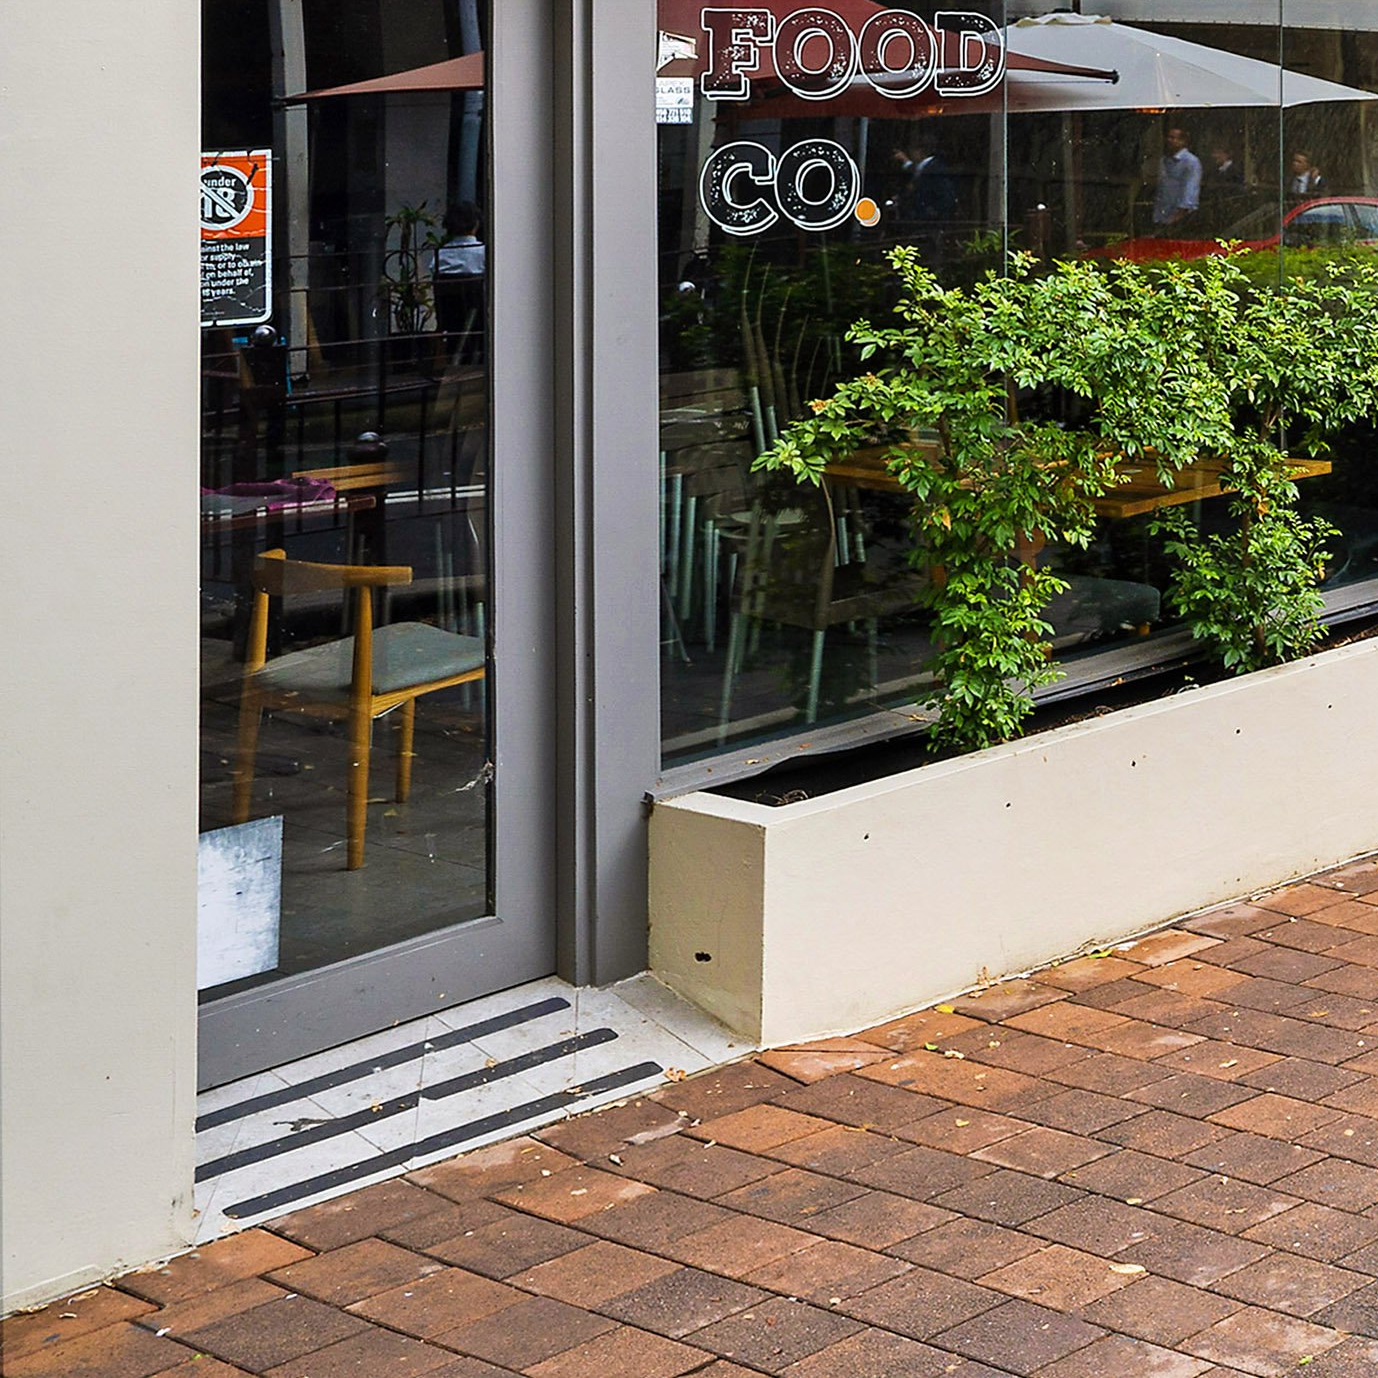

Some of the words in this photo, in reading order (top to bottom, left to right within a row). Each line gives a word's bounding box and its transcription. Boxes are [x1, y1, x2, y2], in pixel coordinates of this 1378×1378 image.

[701, 8, 1006, 100] FOOD
[700, 138, 881, 236] CO.
[235, 242, 250, 251] law
